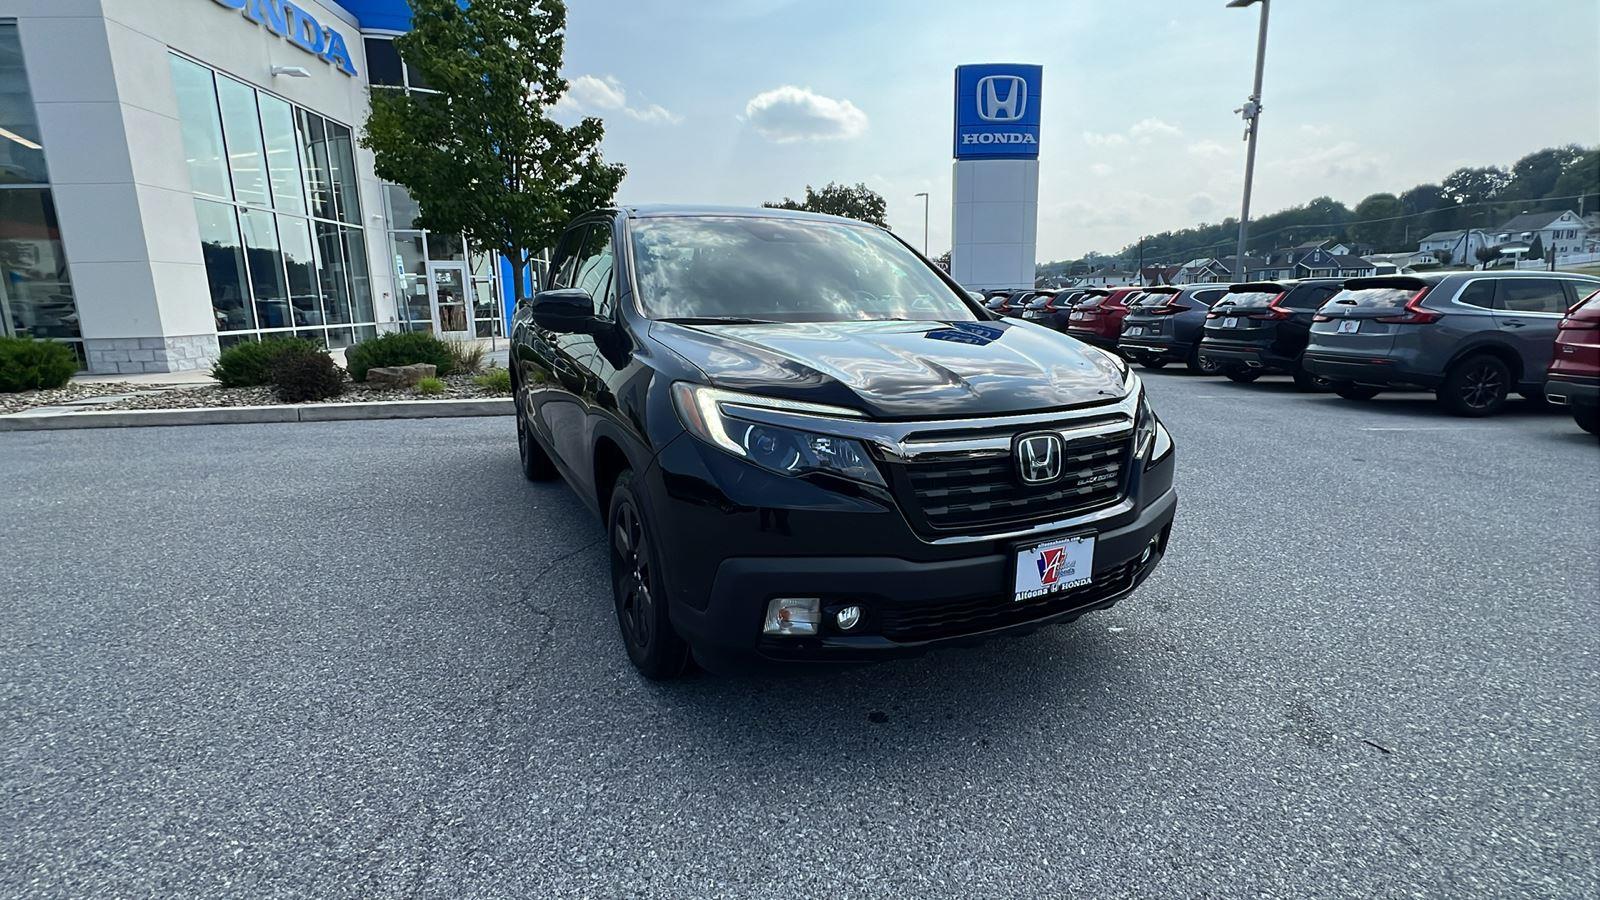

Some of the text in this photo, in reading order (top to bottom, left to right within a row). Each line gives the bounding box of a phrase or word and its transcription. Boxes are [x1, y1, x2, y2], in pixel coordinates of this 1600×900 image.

[212, 0, 357, 77] NDA
[962, 132, 1037, 144] HONDA
[1015, 588, 1048, 601] Altoona
[1061, 577, 1092, 591] HONDA
